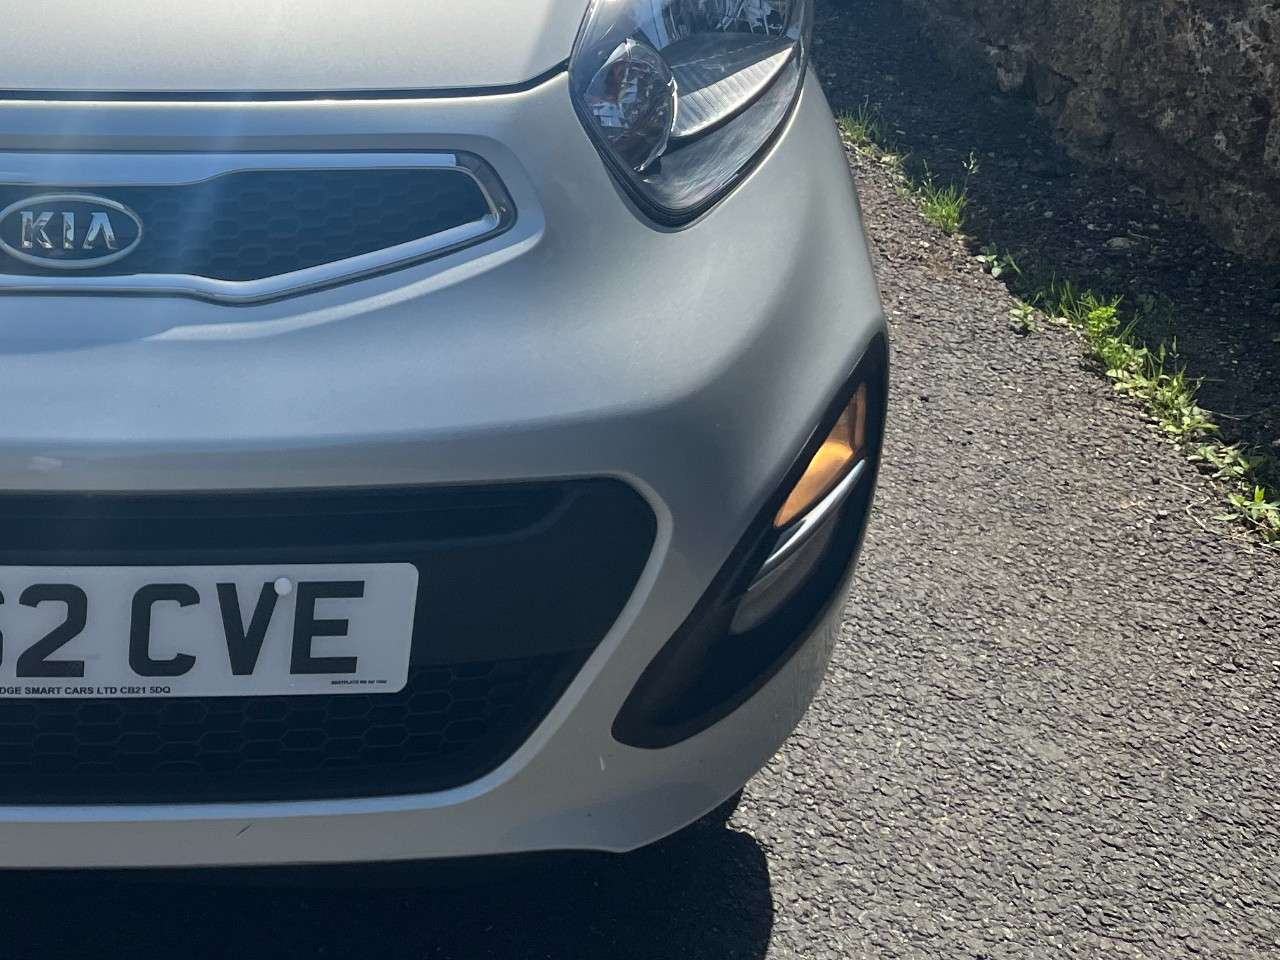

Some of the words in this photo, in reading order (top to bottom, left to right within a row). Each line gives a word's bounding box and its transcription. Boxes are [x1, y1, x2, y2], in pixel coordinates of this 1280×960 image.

[20, 211, 118, 250] KIA
[128, 580, 366, 677] CVE
[24, 685, 62, 696] SMART
[64, 685, 94, 696] CARS
[97, 685, 118, 696] LTD
[120, 685, 146, 695] CB21
